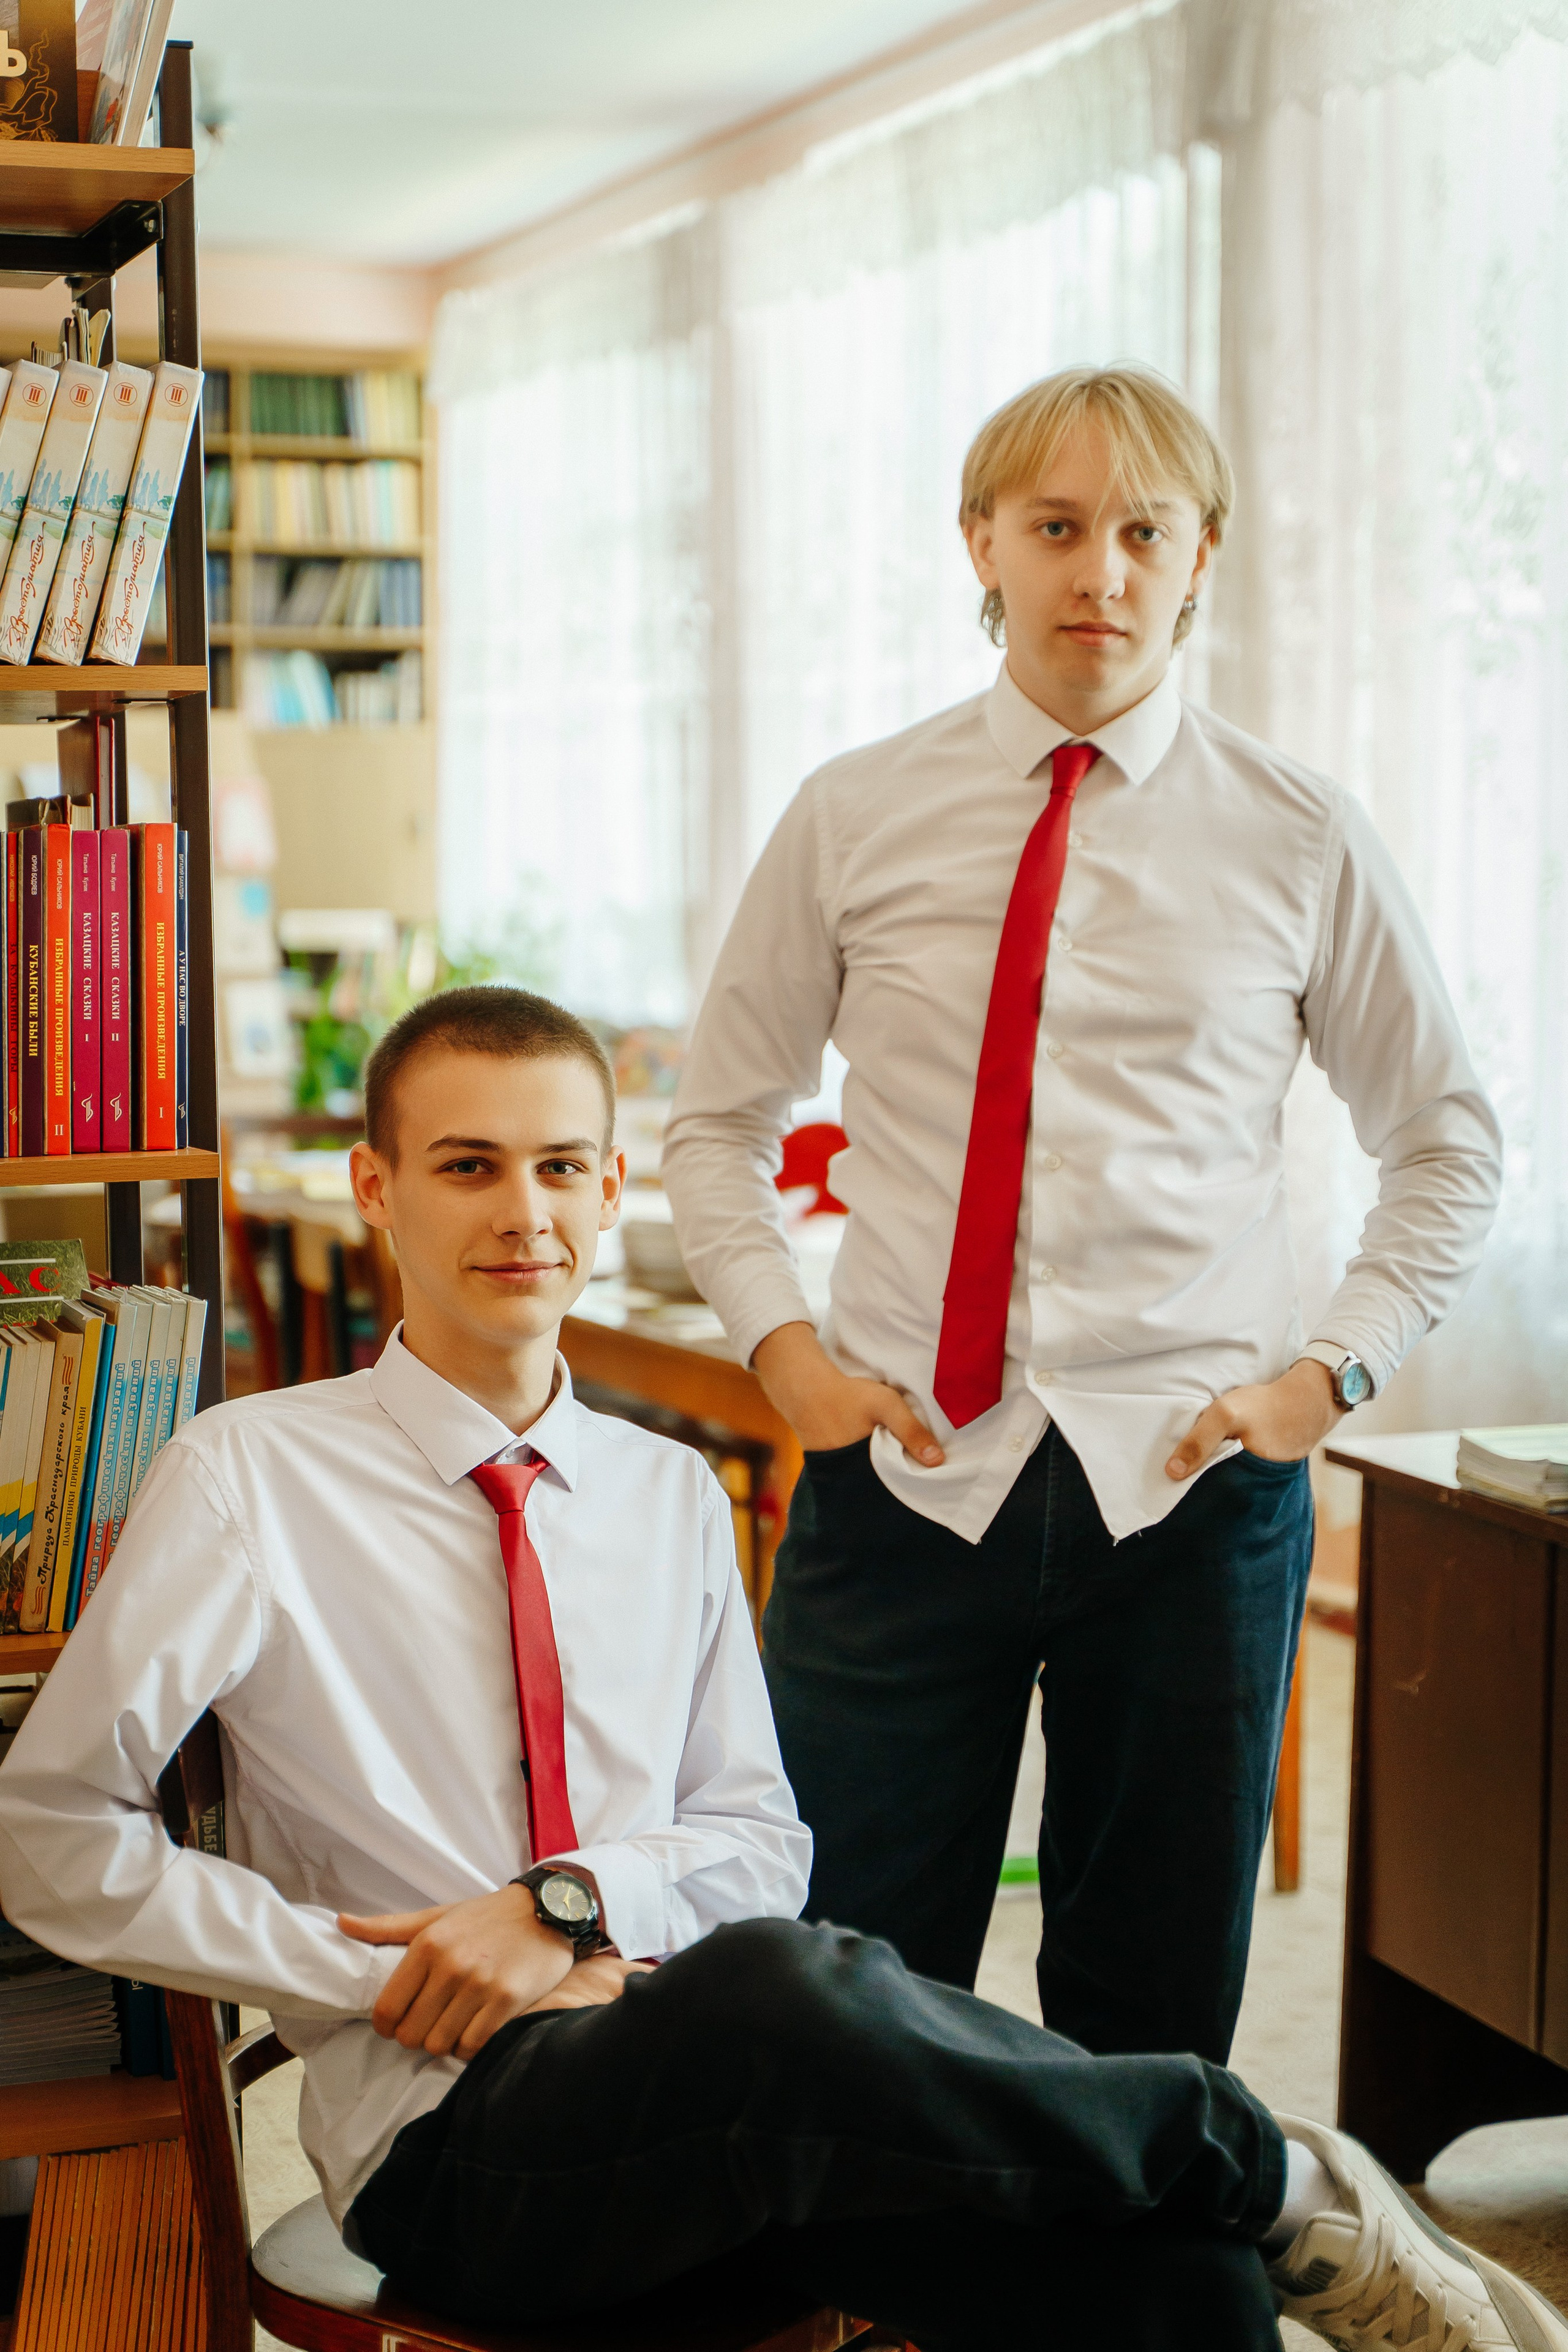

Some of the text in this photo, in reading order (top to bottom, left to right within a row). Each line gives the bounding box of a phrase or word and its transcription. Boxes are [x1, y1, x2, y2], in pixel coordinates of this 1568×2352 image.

[9, 521, 47, 647] Хрестоматия
[64, 521, 96, 648] Хрестоматия
[115, 521, 146, 647] Хрестоматия
[29, 944, 39, 1057] КУБАНСКИЕ БЫЛИ
[54, 938, 64, 1096] ИЗБРАННЫЕ ПРОИЗВЕДЕНИЯ
[82, 912, 92, 1020] КАЗАЦКИЕ СКАЗКИ
[110, 911, 120, 1020] КАЗАЦКИЕ СКАЗКИ
[156, 922, 166, 1079] ИЗБРАННЫЕ ПРОИЗВЕДЕНИЯ
[179, 985, 186, 997] ВО
[126, 1360, 141, 1426] названий
[145, 1360, 160, 1426] названий
[161, 1359, 176, 1425] названий
[182, 1357, 196, 1423] названий
[37, 1385, 70, 1585] Природа Краснодарского края
[62, 1406, 87, 1547] ПАМЯТНИКИ ПРИРОДЫ КУБАНИ
[85, 1363, 126, 1597] Тайна географических названий
